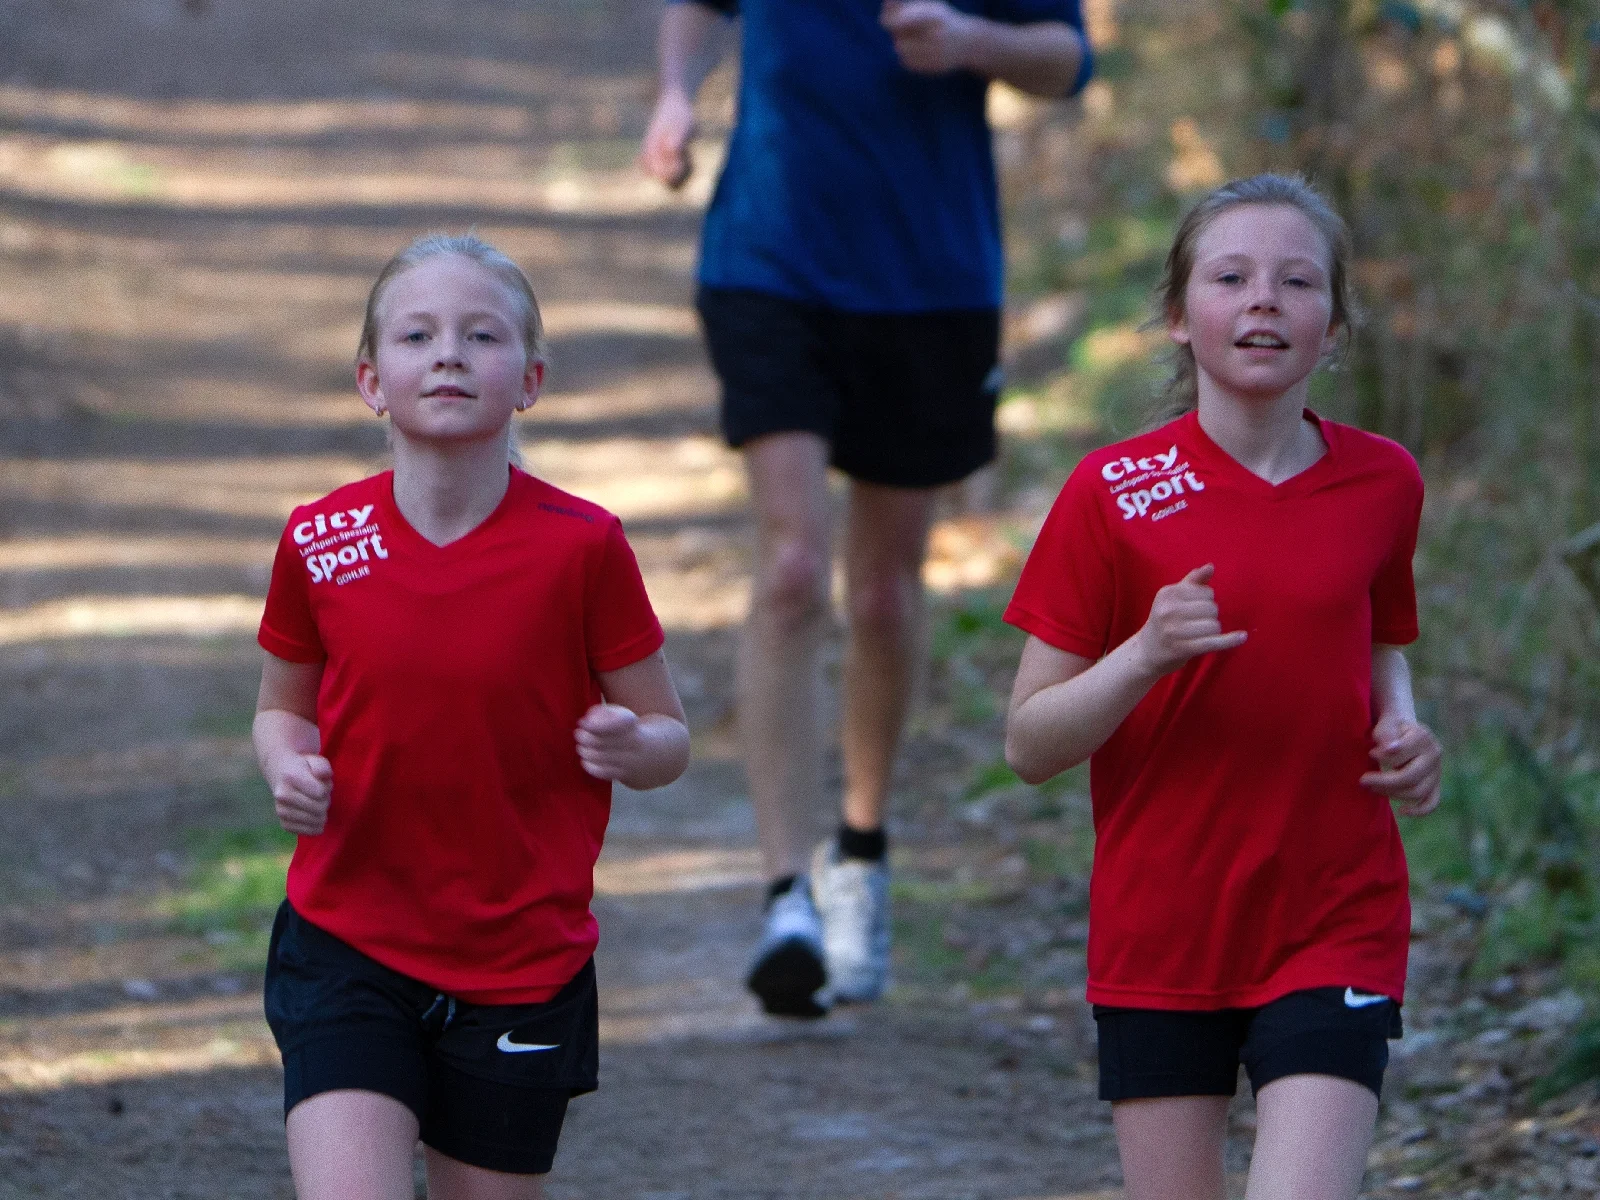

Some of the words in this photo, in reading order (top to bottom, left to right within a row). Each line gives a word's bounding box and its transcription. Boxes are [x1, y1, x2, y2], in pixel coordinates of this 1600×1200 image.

[1101, 444, 1178, 482] City
[1116, 470, 1205, 520] Sport
[293, 504, 374, 545] City
[306, 532, 389, 584] Sport
[336, 565, 371, 586] GOHLKE
